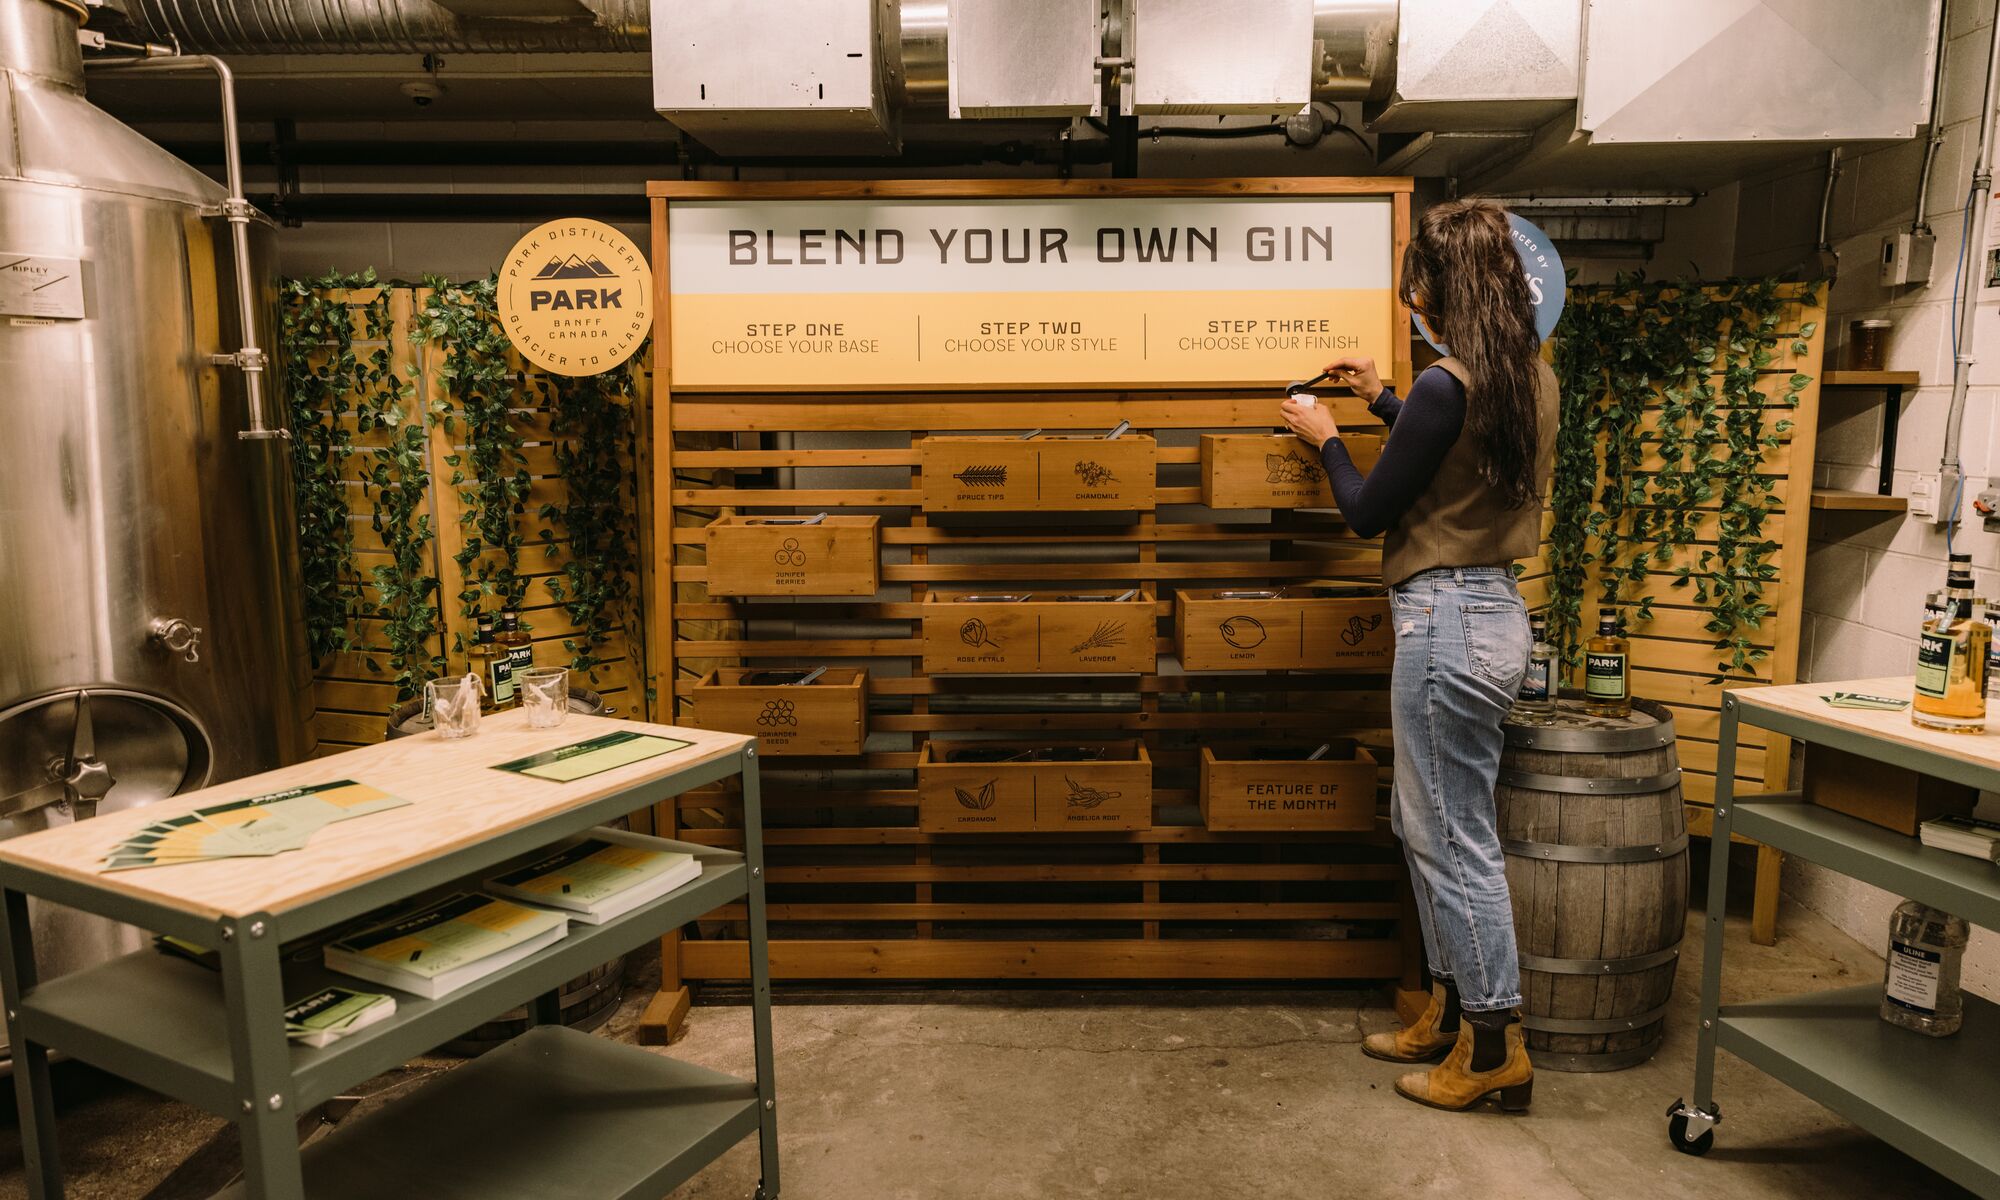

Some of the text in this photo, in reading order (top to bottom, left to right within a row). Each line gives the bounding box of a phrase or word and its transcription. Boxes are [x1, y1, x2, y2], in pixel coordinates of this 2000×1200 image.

[729, 226, 1333, 265] BLEND YOUR OWN GIN
[510, 227, 641, 278] PARK DISTILLERY
[1536, 255, 1549, 268] BY
[12, 265, 48, 274] RIPLEY
[530, 288, 622, 311] PARK
[553, 318, 601, 328] BANFF
[980, 321, 1081, 335] STEP TWO
[1208, 319, 1330, 333] STEP THREE
[549, 330, 608, 340] CANADA
[746, 323, 845, 337] STEP ONE
[510, 310, 645, 367] GLACIER TO GLASS
[944, 337, 1118, 352] CHOOSE YOUR STYLE
[1178, 335, 1360, 350] CHOOSE YOUR FINISH
[711, 339, 879, 354] CHOOSE YOUR BASE
[1920, 639, 1943, 653] RK
[498, 662, 512, 673] PA
[1529, 662, 1545, 671] RK
[1588, 657, 1619, 668] PARK
[1247, 784, 1339, 795] FEATURE OF
[1248, 799, 1337, 810] THE MONTH
[1102, 814, 1121, 822] ROOT
[1903, 946, 1926, 959] ULINE
